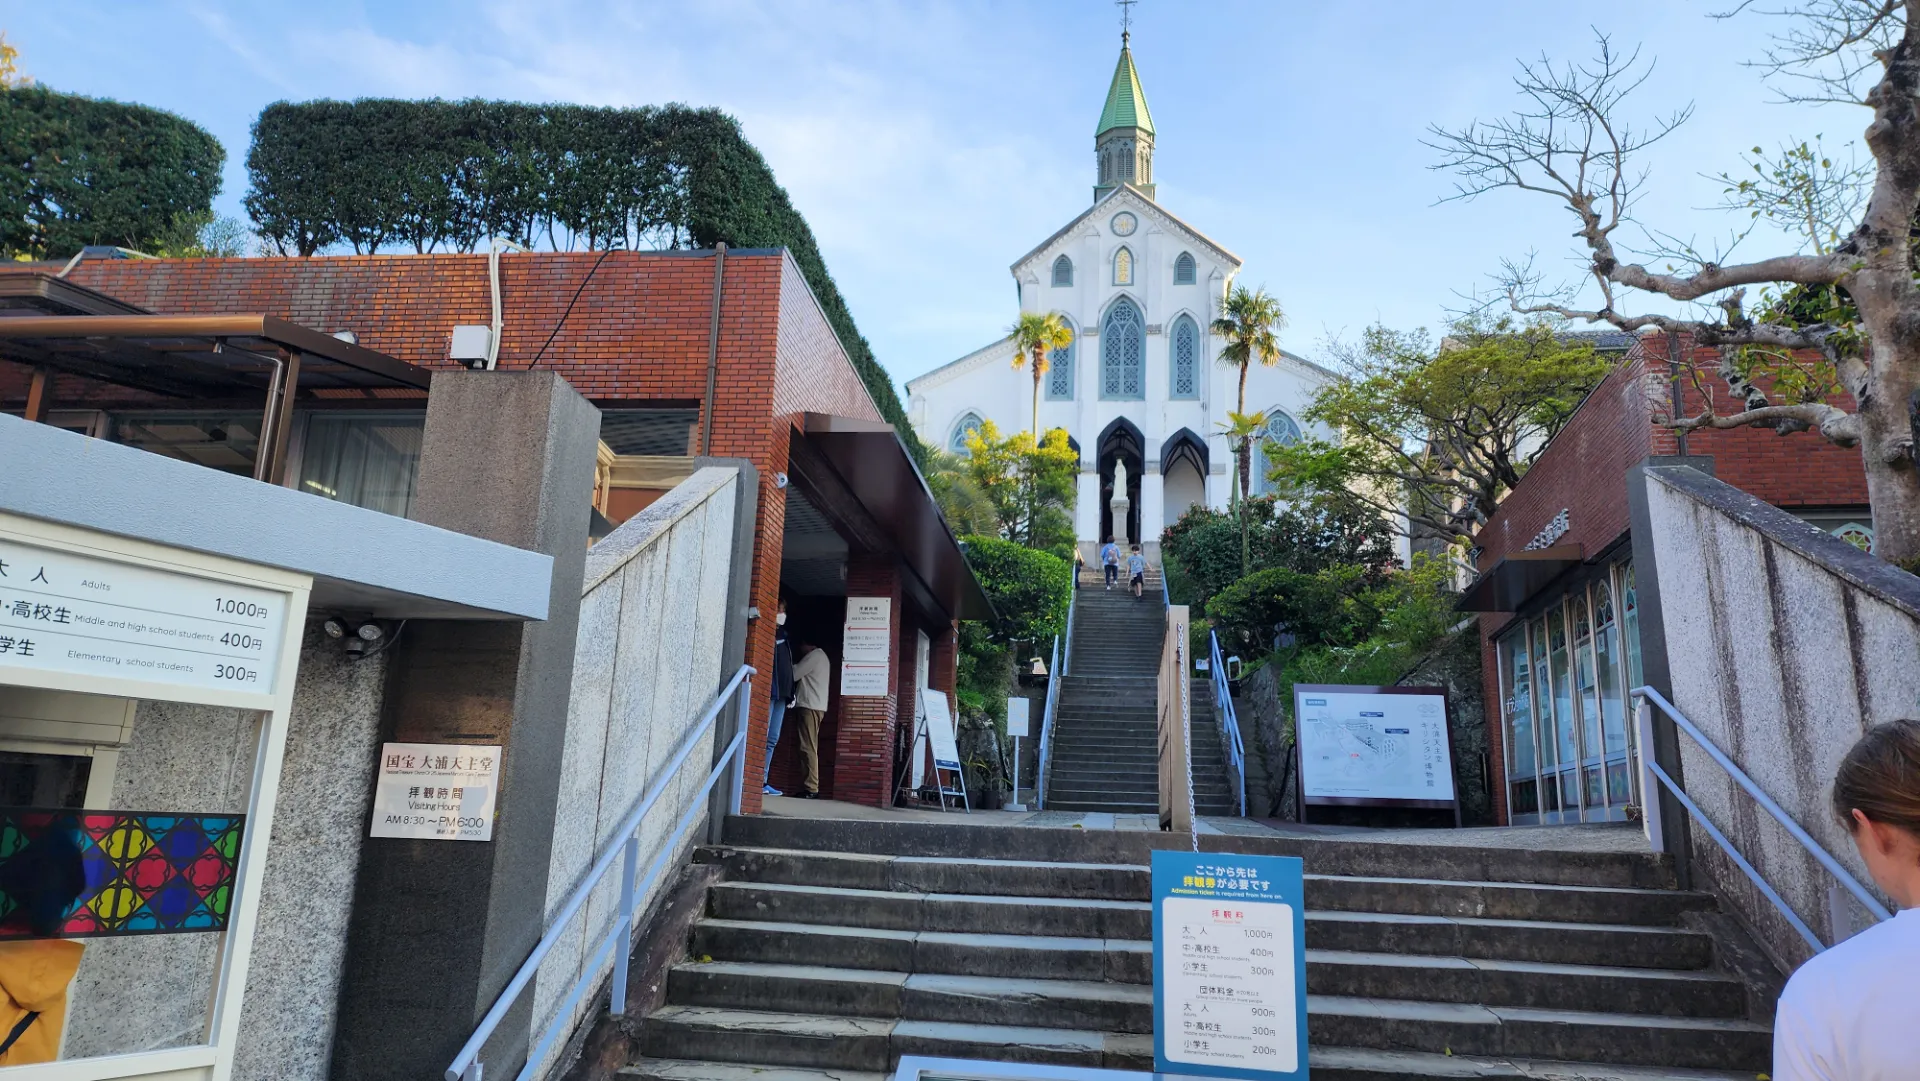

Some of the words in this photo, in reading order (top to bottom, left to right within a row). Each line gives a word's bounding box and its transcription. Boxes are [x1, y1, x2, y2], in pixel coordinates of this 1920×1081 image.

[81, 580, 111, 591] Adults
[0, 600, 71, 624] ・高校生
[215, 598, 267, 619] 1,000円
[74, 614, 105, 626] Middle
[107, 619, 125, 629] and
[127, 622, 147, 633] high
[149, 625, 177, 636] school
[179, 629, 215, 642] students
[220, 632, 262, 651] 400円
[67, 650, 121, 665] Elementary
[126, 657, 155, 669] school
[157, 661, 194, 673] students
[214, 664, 257, 682] 300円
[408, 801, 436, 811] Visiting
[437, 802, 460, 811] Hours
[1195, 865, 1257, 878] ここから先は
[1244, 929, 1273, 939] 1,000円
[1250, 948, 1274, 957] 400円
[1183, 962, 1208, 972] 小学生
[1251, 966, 1274, 976] 300円
[1200, 985, 1234, 996] 団体料金
[1251, 1007, 1276, 1017] 900円
[1252, 1026, 1276, 1036] 300円
[1184, 1040, 1210, 1050] 小学生
[1252, 1045, 1277, 1055] 200円
